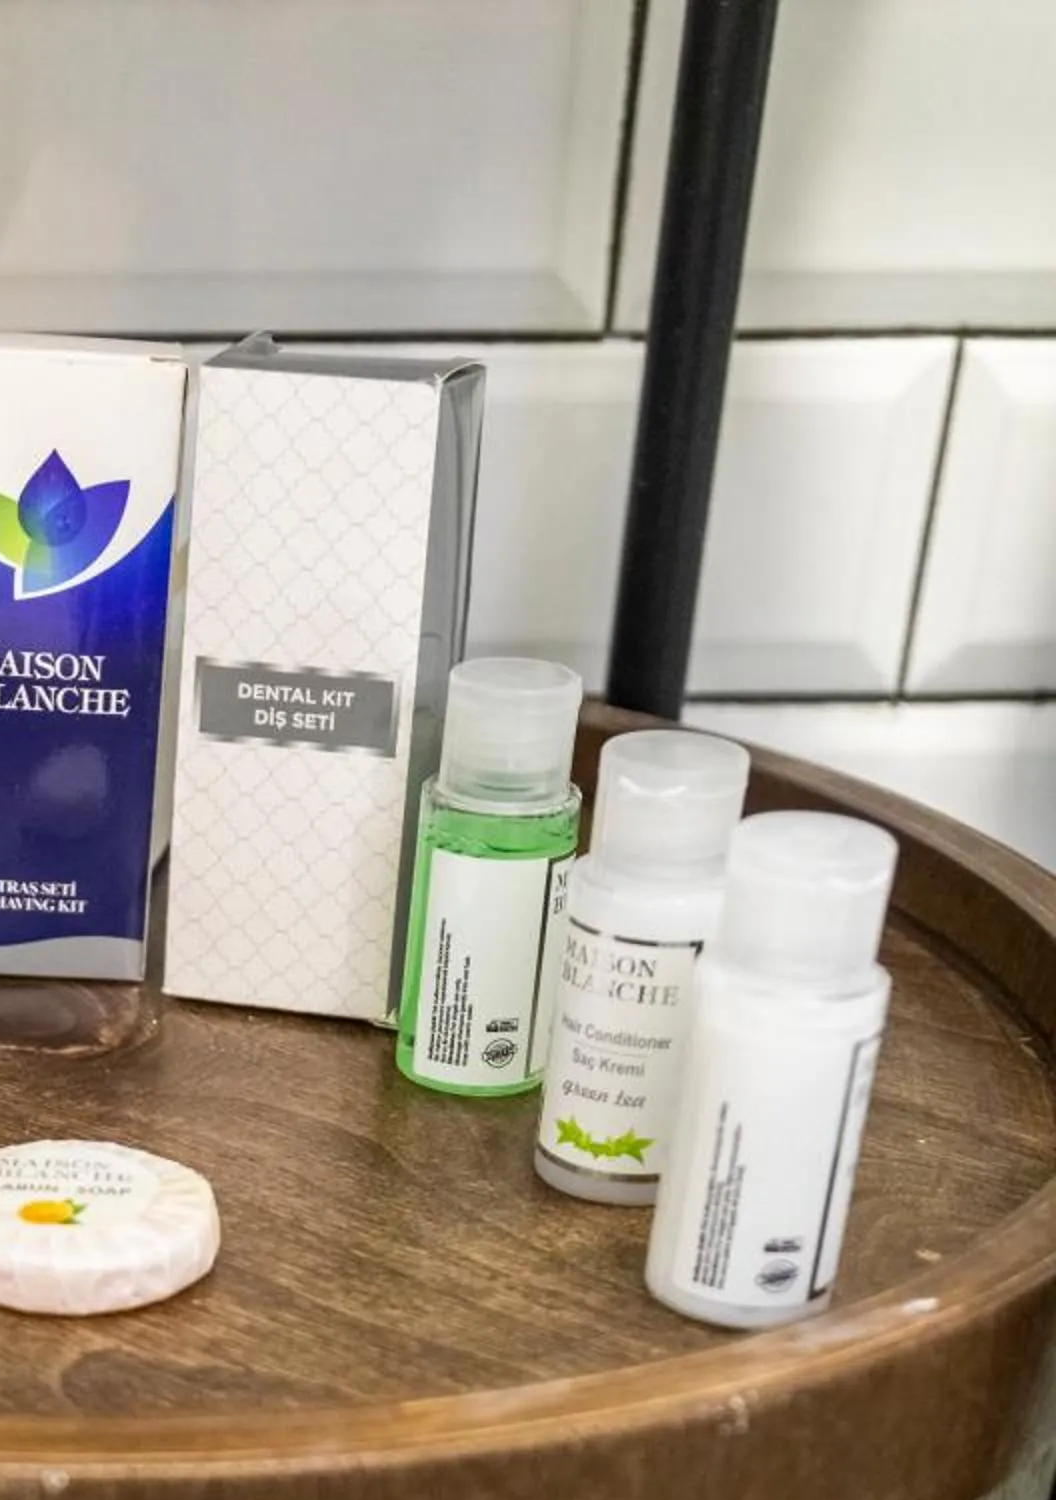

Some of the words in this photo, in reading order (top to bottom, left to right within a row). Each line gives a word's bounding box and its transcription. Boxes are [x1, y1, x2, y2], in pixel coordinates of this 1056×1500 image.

[238, 682, 317, 705] DENTAL
[322, 690, 355, 708] KIT
[57, 899, 88, 914] KIT
[585, 1023, 673, 1050] Conditioner
